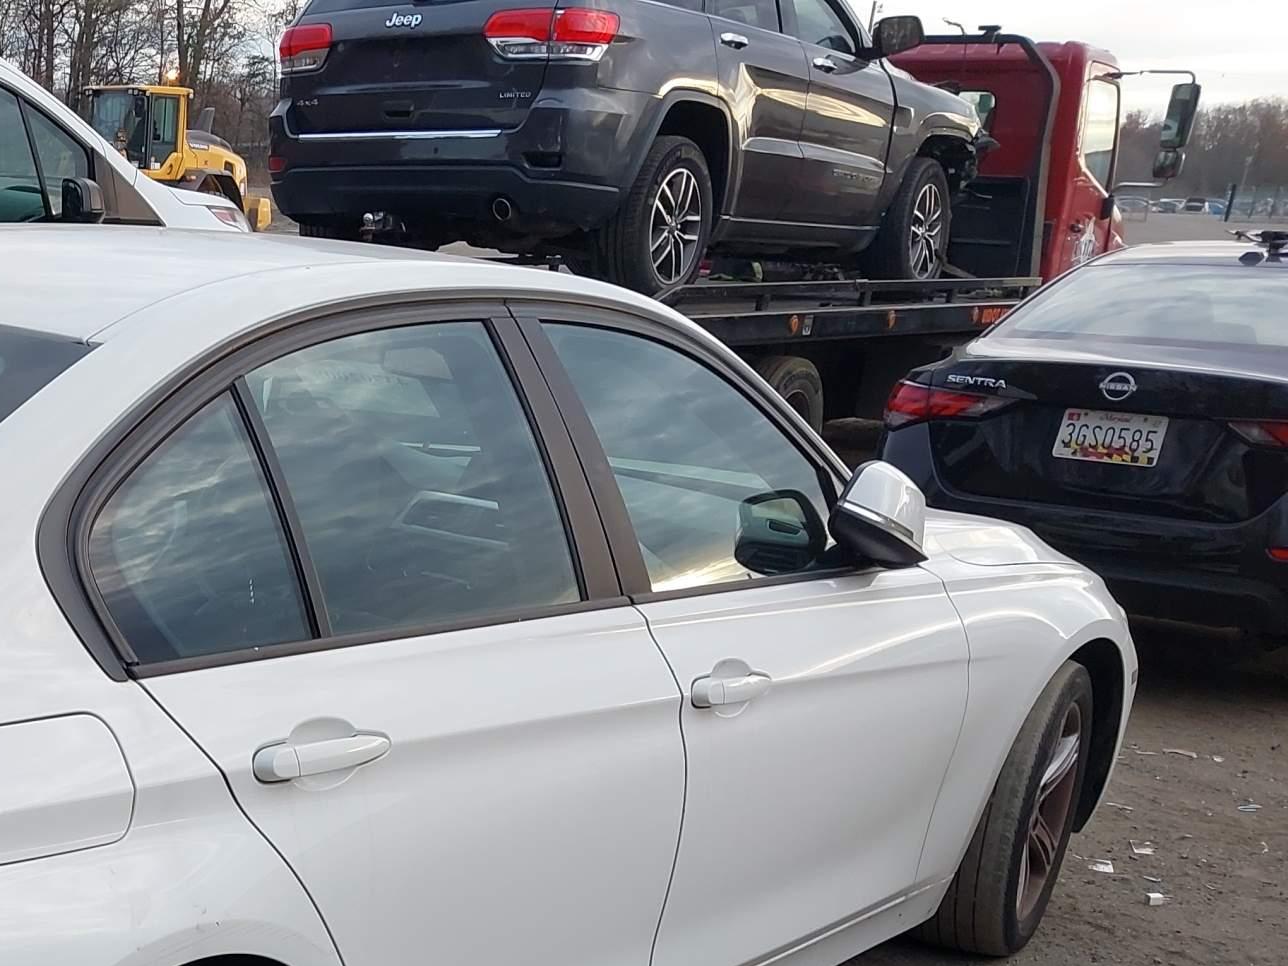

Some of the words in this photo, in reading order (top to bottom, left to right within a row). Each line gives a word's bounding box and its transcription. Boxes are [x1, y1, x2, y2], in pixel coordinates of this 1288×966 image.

[385, 13, 423, 29] Jeep
[946, 374, 1007, 389] SENTRA
[1098, 381, 1138, 392] NISSAN
[1061, 422, 1159, 454] 3GS0585
